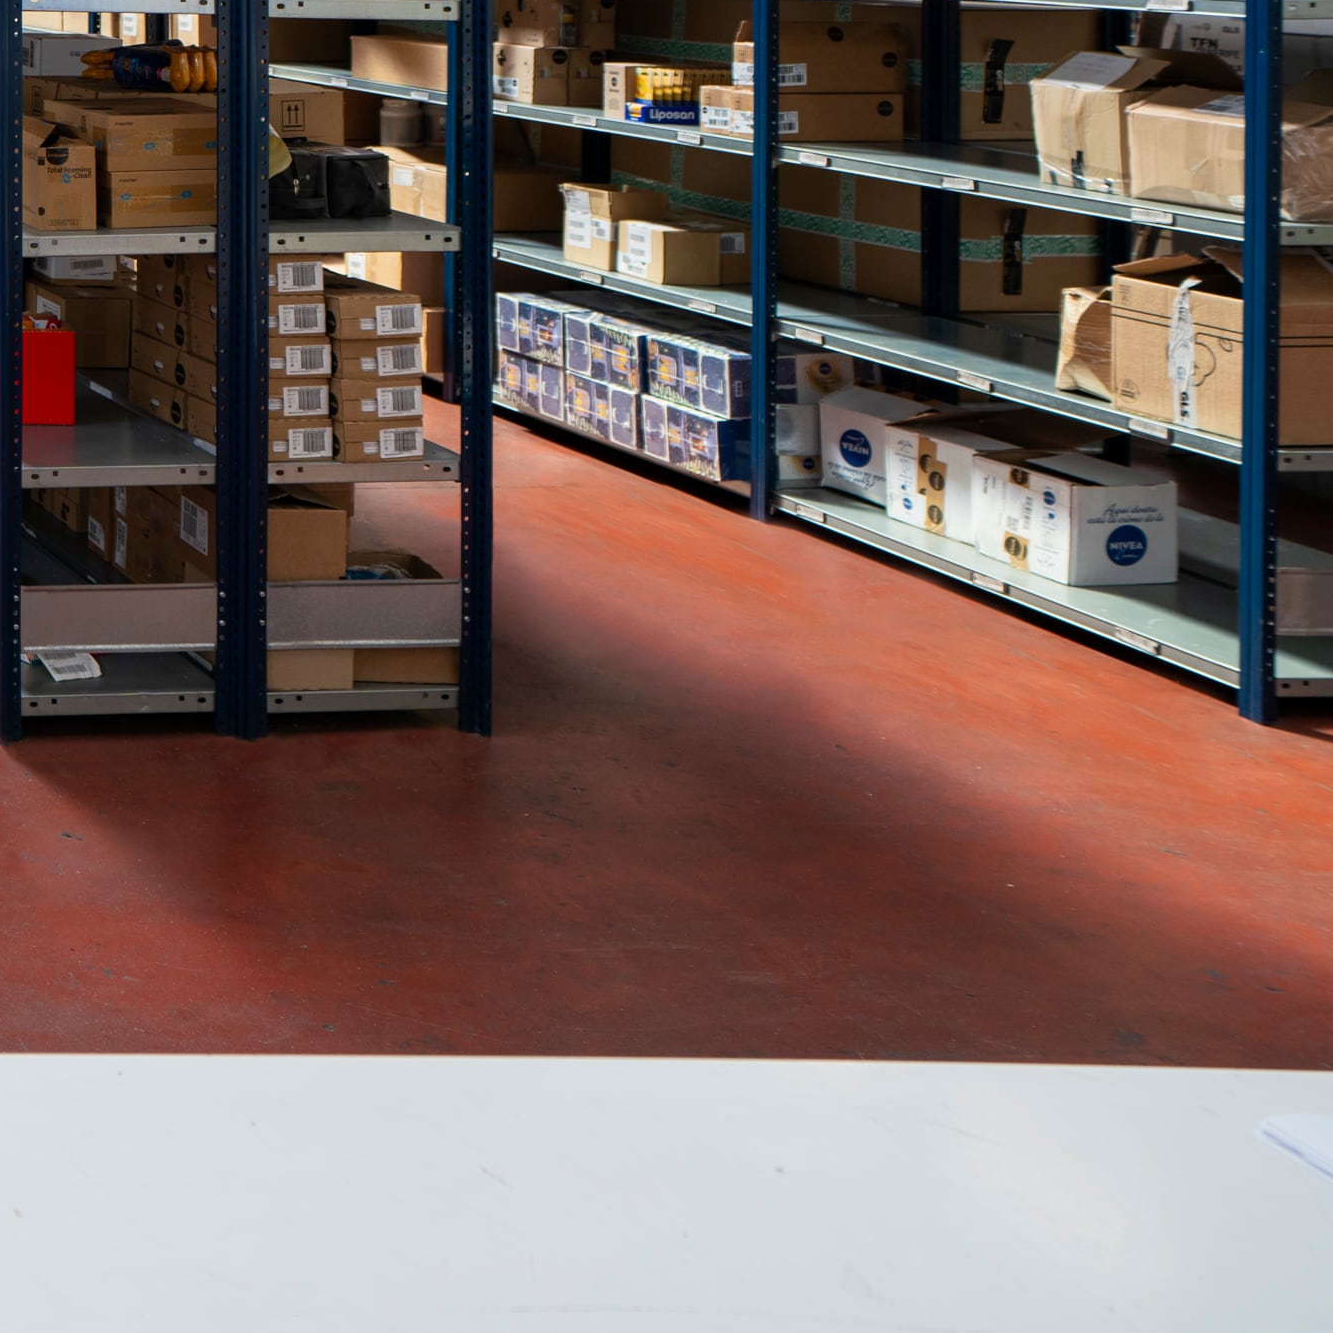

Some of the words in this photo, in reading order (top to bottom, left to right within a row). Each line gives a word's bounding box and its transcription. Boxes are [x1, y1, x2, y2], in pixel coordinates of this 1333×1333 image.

[650, 108, 695, 121] Liposan
[841, 442, 870, 456] NIVEA
[1110, 542, 1143, 550] NIVEA
